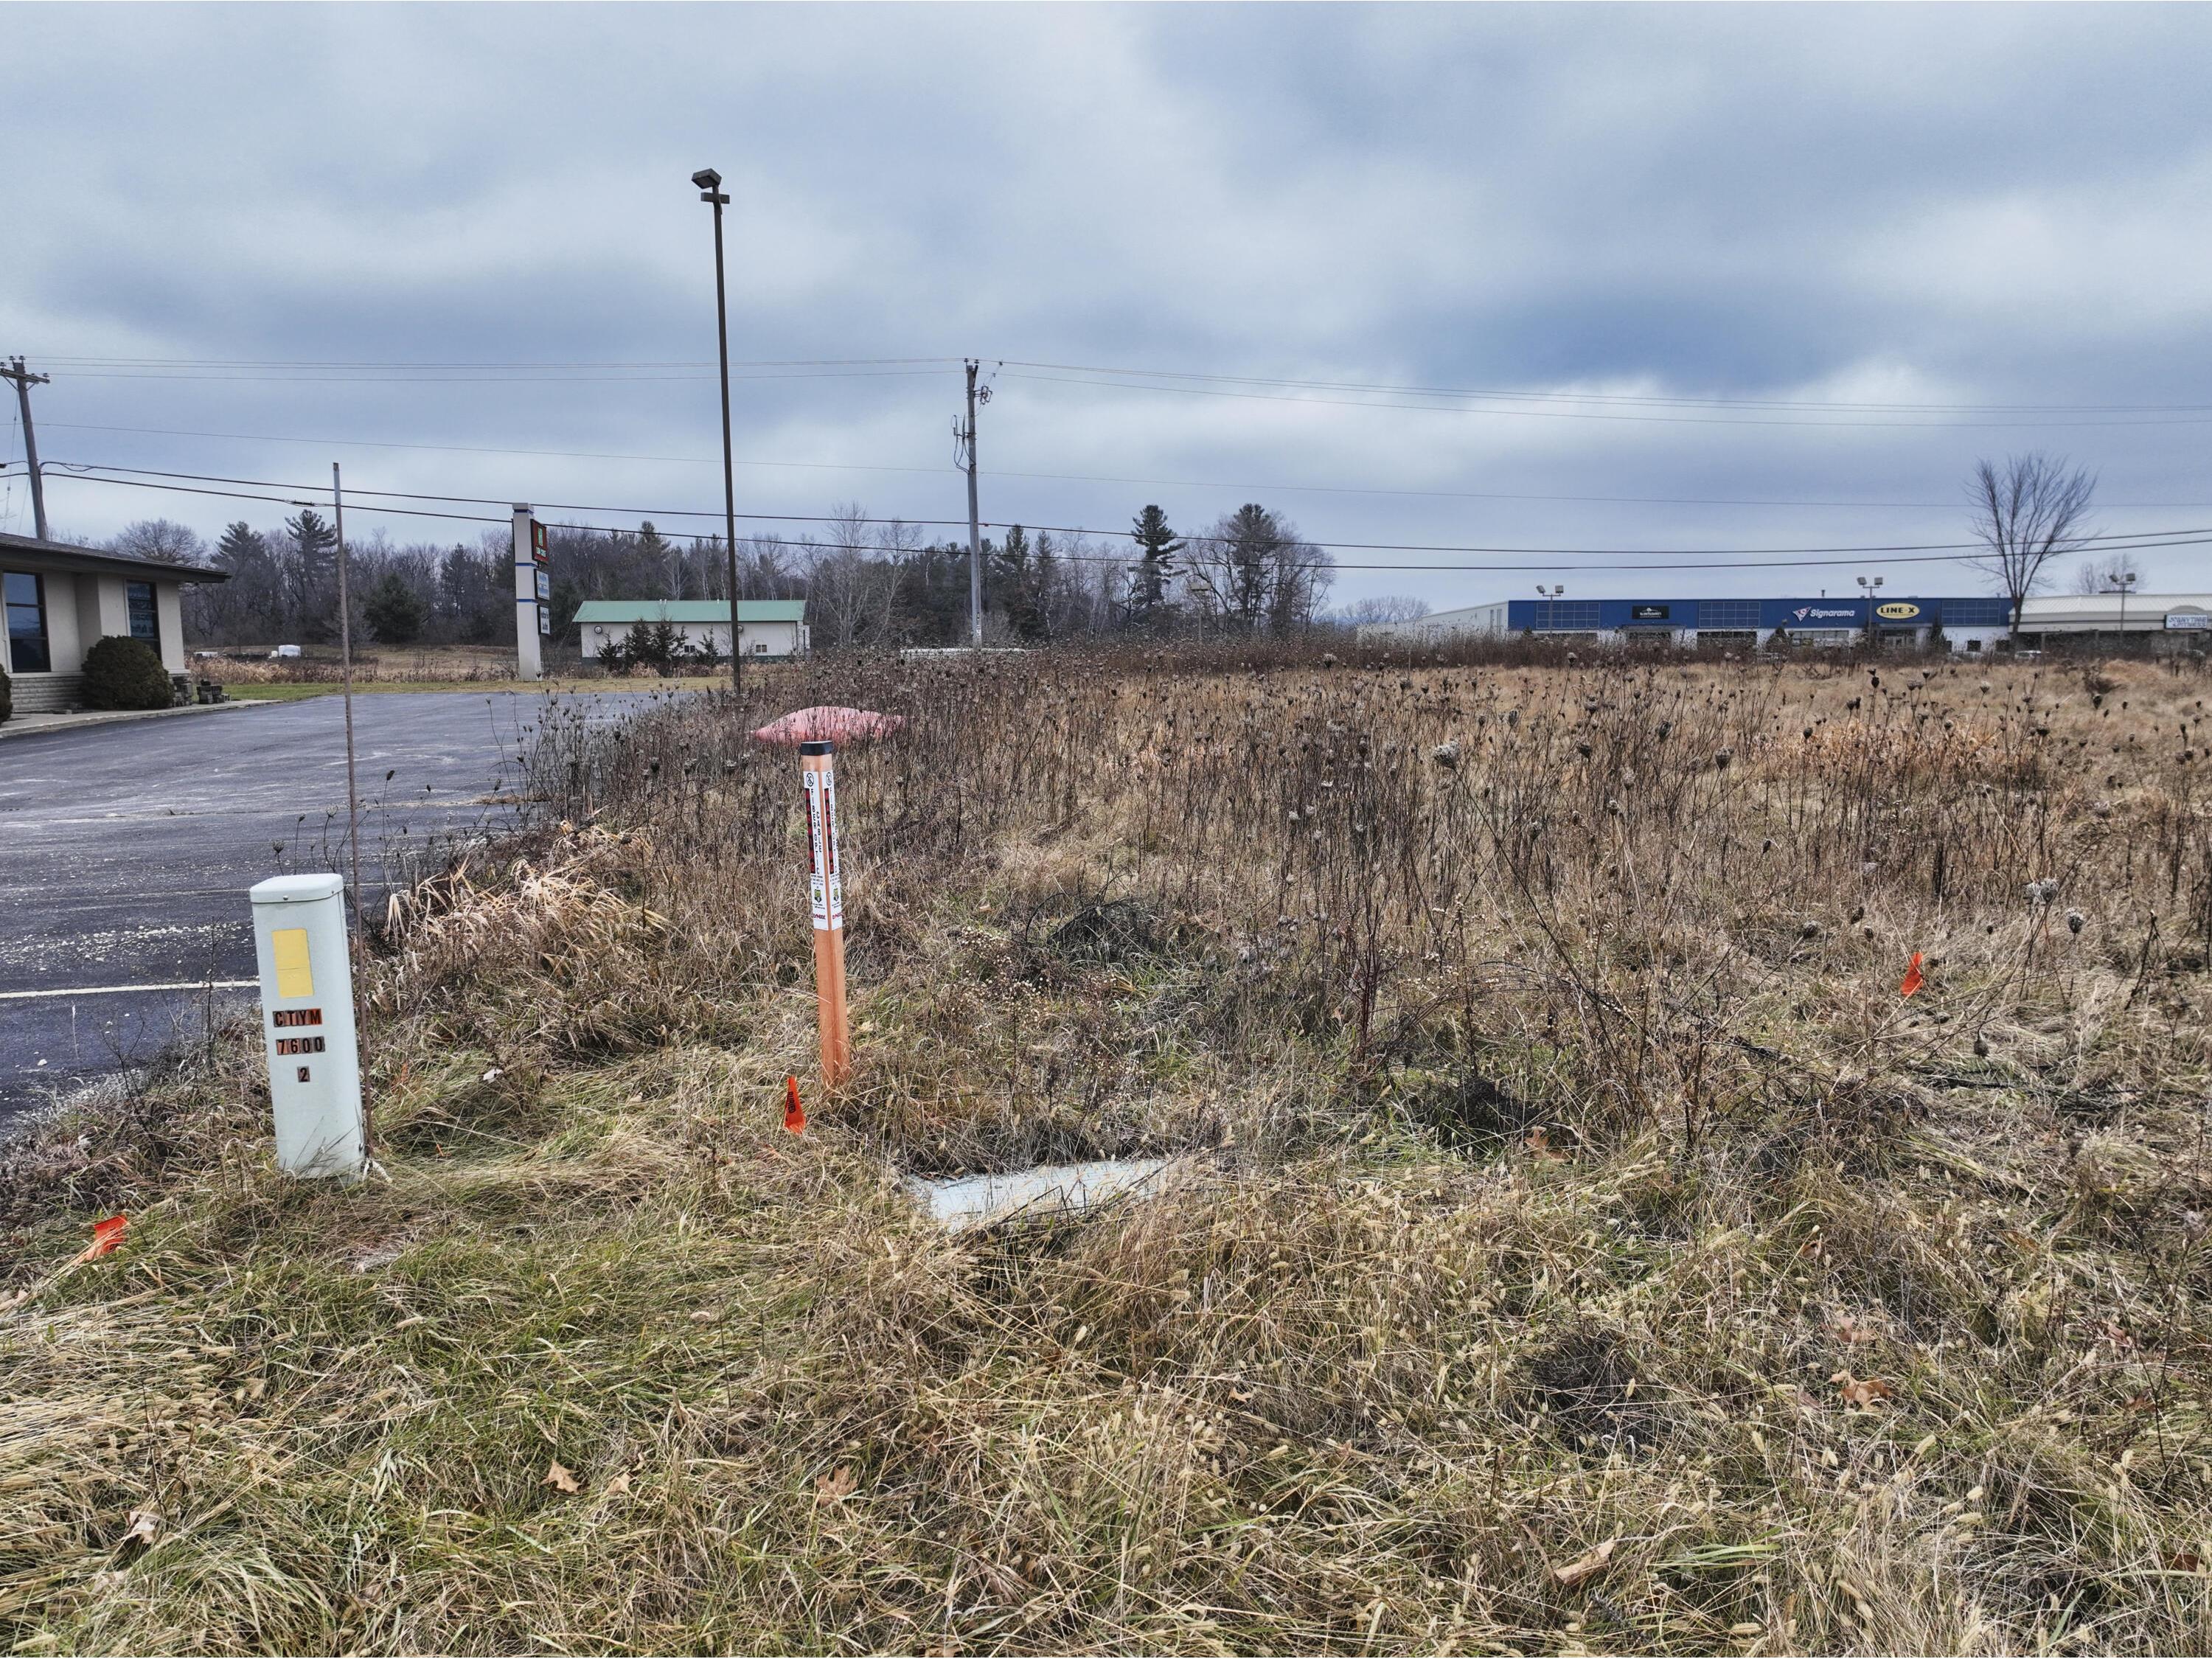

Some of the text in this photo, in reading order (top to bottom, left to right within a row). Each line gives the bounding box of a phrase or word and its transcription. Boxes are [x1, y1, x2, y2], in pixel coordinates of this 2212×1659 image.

[1809, 609, 1855, 618] Signarama
[275, 1009, 321, 1026] CTYM
[278, 1037, 323, 1054] 7600
[300, 1067, 308, 1082] 2
